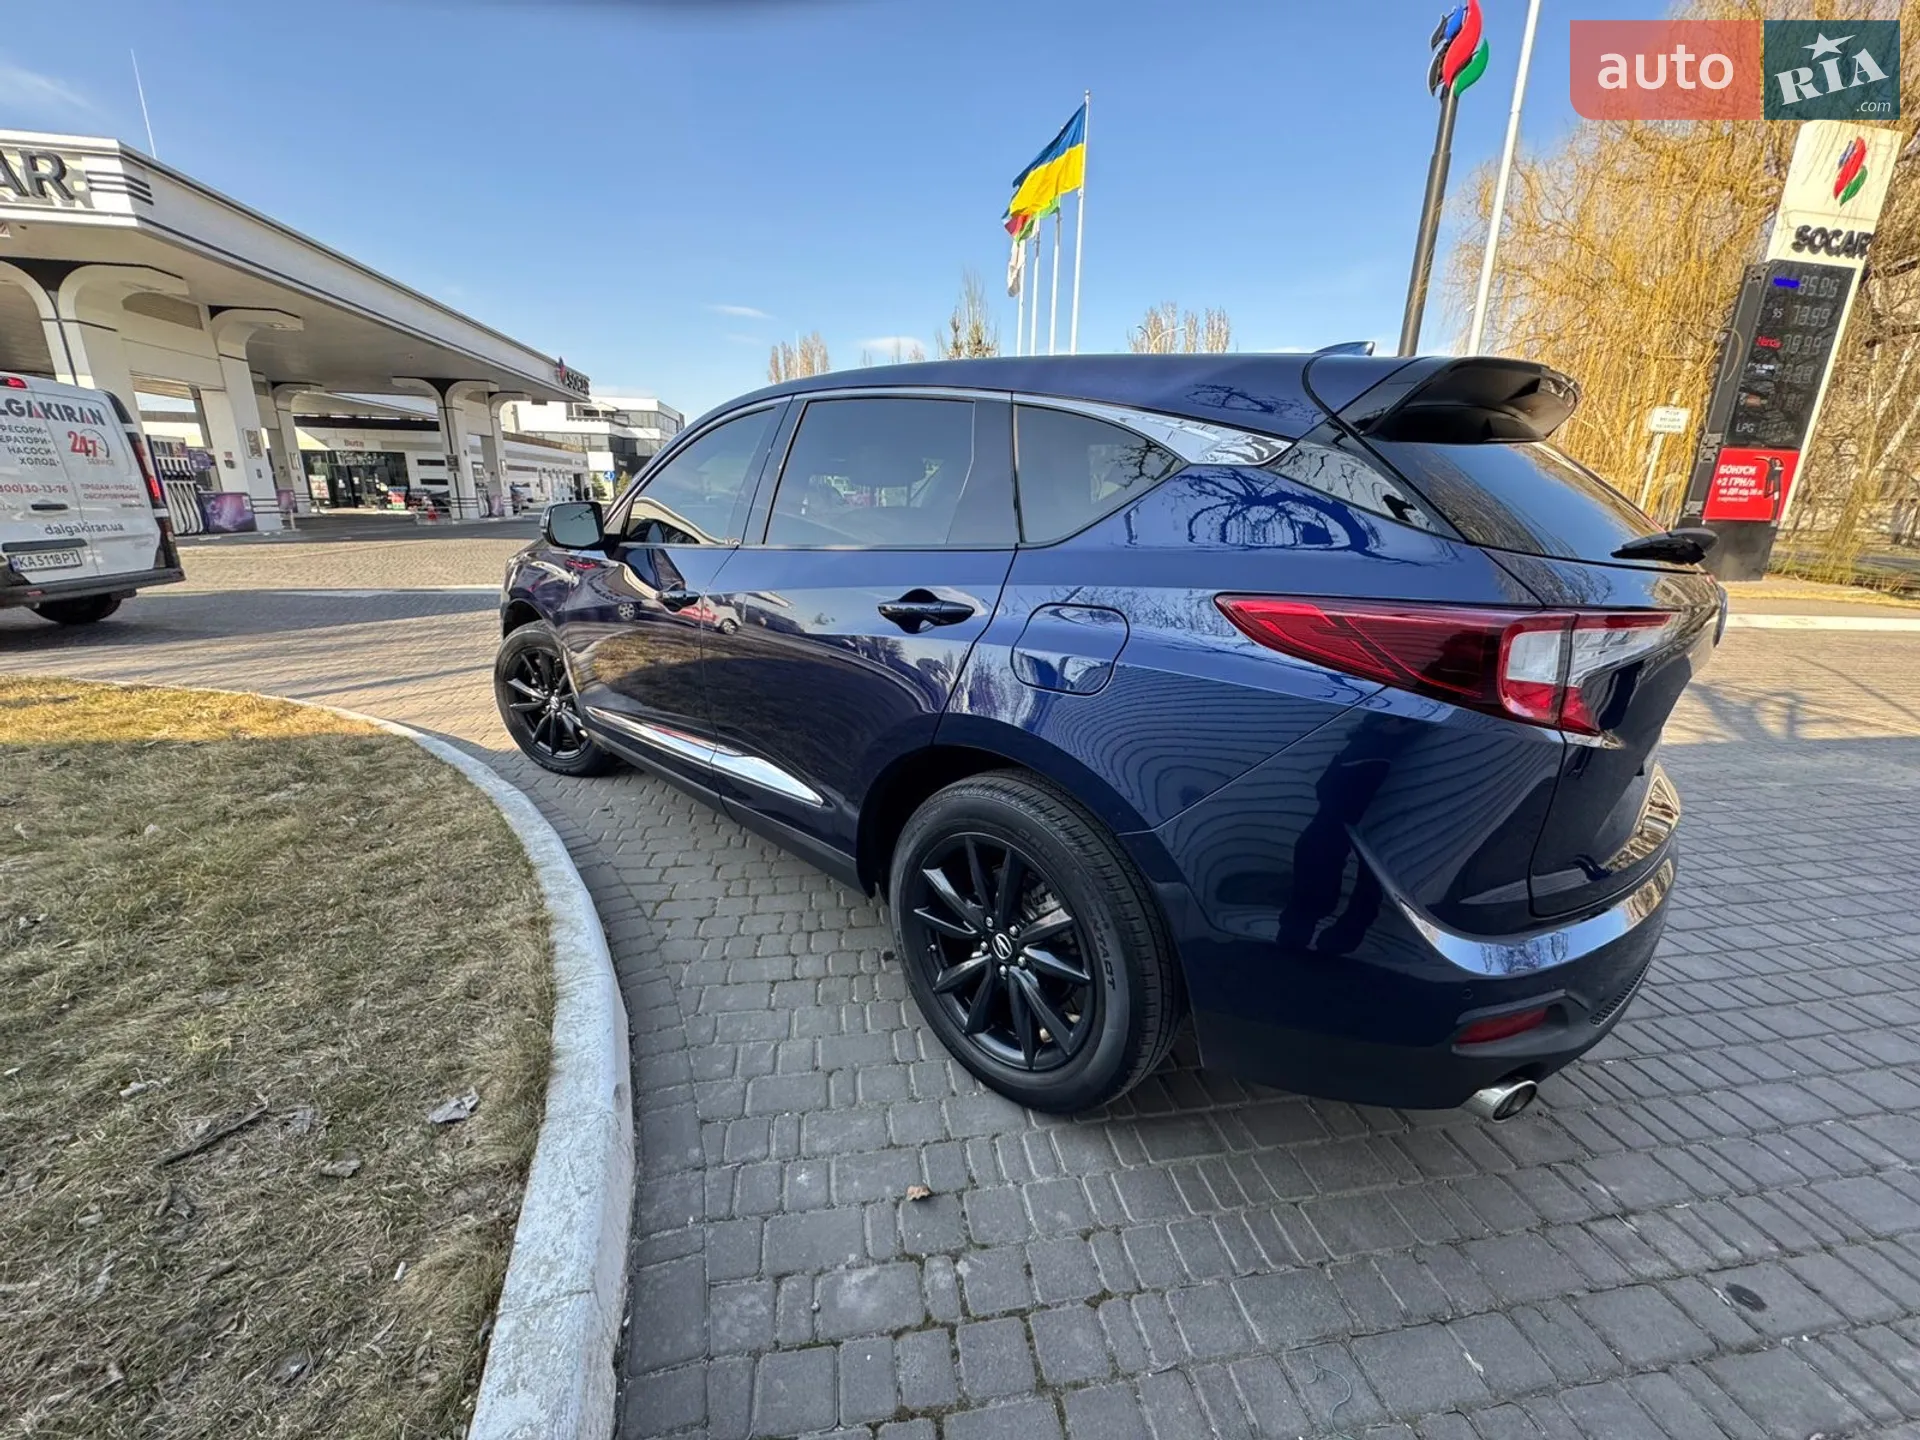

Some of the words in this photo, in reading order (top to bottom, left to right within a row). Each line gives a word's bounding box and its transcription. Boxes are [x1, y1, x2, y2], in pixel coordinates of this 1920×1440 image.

[1791, 224, 1874, 261] SOCAR
[1735, 422, 1755, 434] LPG
[1718, 464, 1757, 475] БОНУСИ
